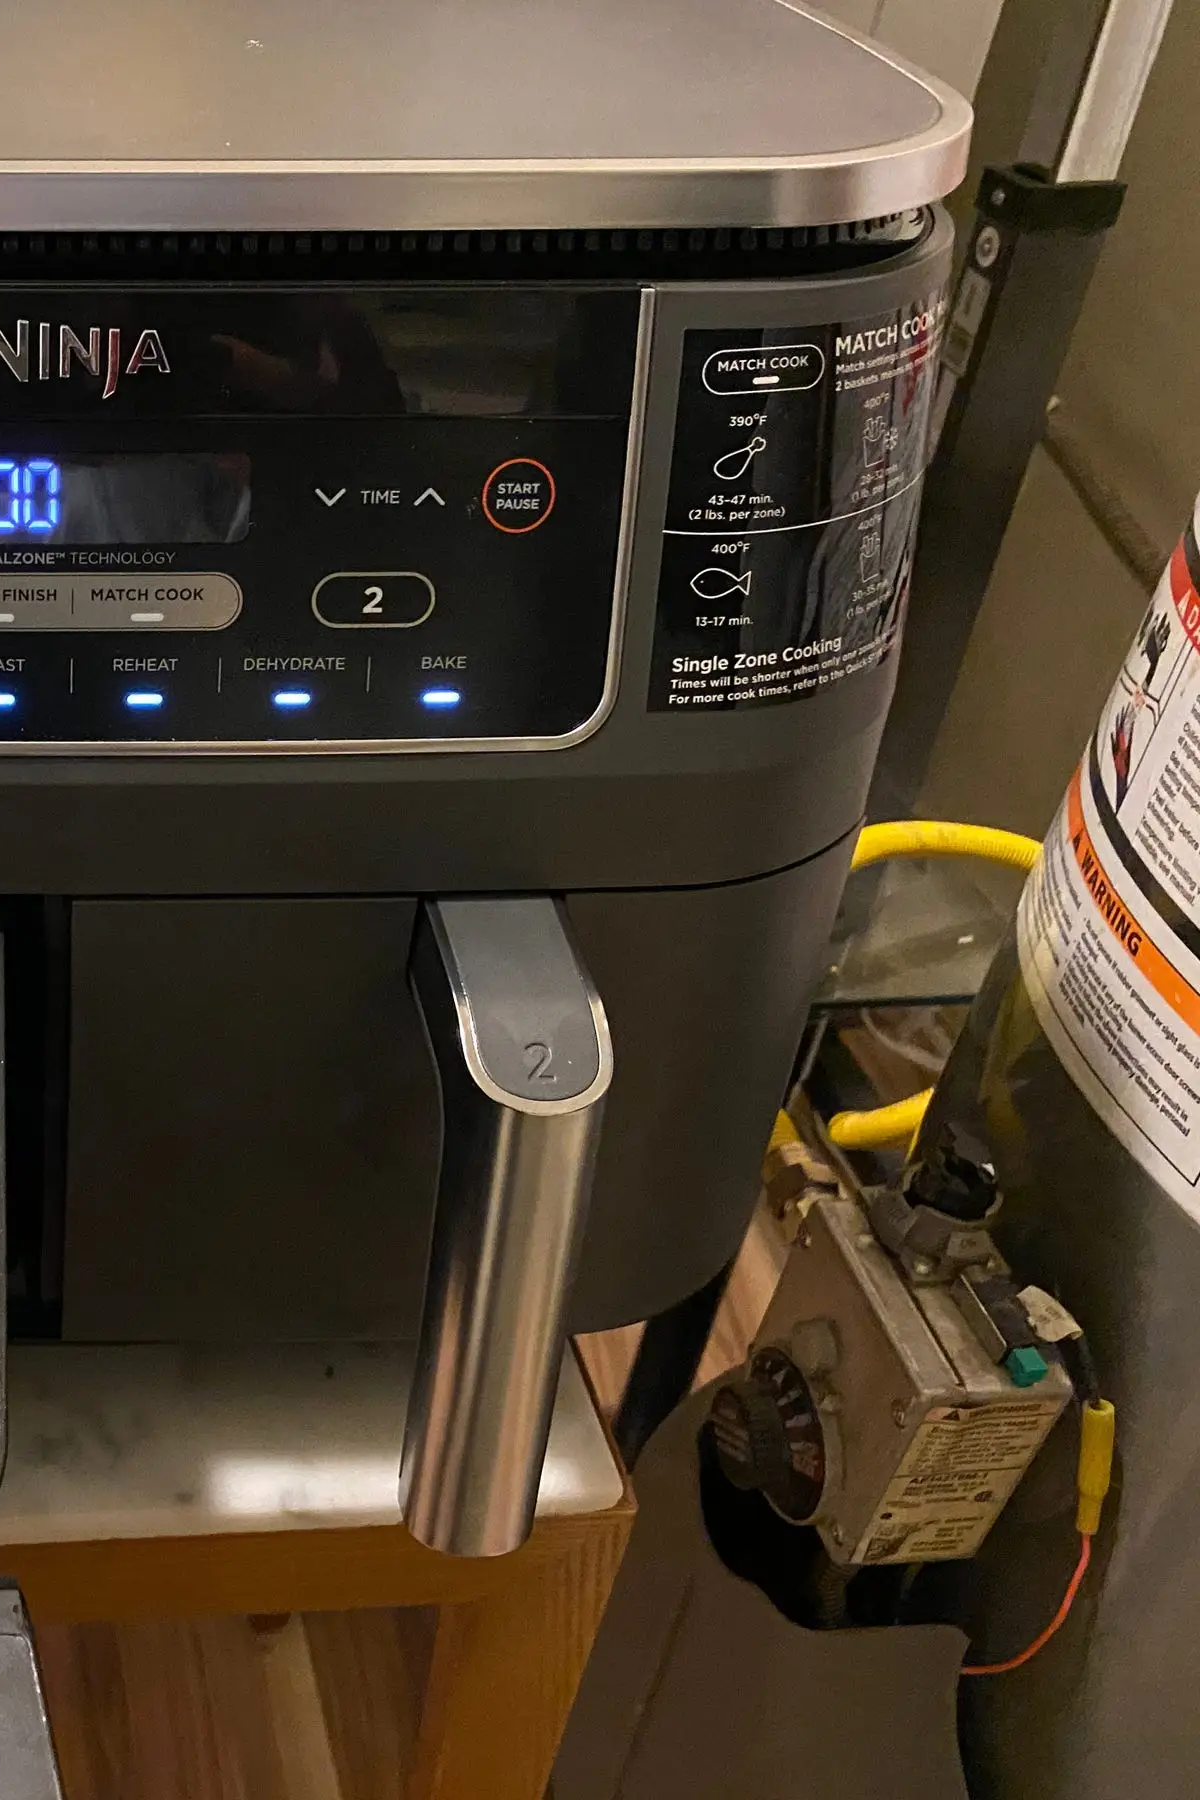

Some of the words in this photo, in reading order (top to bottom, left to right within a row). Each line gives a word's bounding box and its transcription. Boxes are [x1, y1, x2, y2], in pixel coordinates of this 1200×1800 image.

[835, 324, 898, 357] MATCH
[717, 360, 766, 373] MATCH
[770, 355, 809, 369] COOK
[835, 361, 865, 375] Match
[835, 381, 842, 391] 2
[729, 413, 768, 427] 390°F
[497, 483, 541, 496] START
[360, 490, 401, 505] TIME
[496, 498, 540, 511] PAUSE
[748, 494, 774, 505] min.
[688, 509, 702, 521] (2
[704, 508, 728, 520] lbs.
[730, 510, 751, 521] per
[753, 506, 786, 519] zone)
[711, 541, 751, 554] 400°F
[70, 551, 176, 565] TECHNOLOGY
[2, 588, 58, 602] FINISH
[90, 588, 149, 601] MATCH
[154, 588, 205, 601] COOK
[361, 586, 384, 614] 2
[728, 615, 754, 626] min.
[421, 656, 467, 670] BAKE
[671, 654, 729, 675] Single
[733, 651, 777, 669] Zone
[782, 637, 842, 663] Cooking
[112, 658, 179, 672] REHEAT
[243, 657, 346, 671] DEHYDRATE
[671, 678, 706, 690] Times
[709, 675, 731, 687] will
[733, 675, 749, 687] be
[751, 670, 792, 685] shorter
[794, 663, 820, 677] when
[668, 694, 690, 705] For
[692, 693, 724, 704] more
[727, 689, 756, 702] cook
[758, 683, 792, 699] times,
[793, 677, 818, 691] refer
[818, 673, 829, 684] to
[830, 668, 846, 680] the
[1178, 821, 1200, 851] before
[1080, 856, 1143, 957] WARNING
[524, 1041, 557, 1083] 2
[1163, 1062, 1180, 1081] door
[1160, 1091, 1182, 1116] result
[1158, 1103, 1191, 1138] personal
